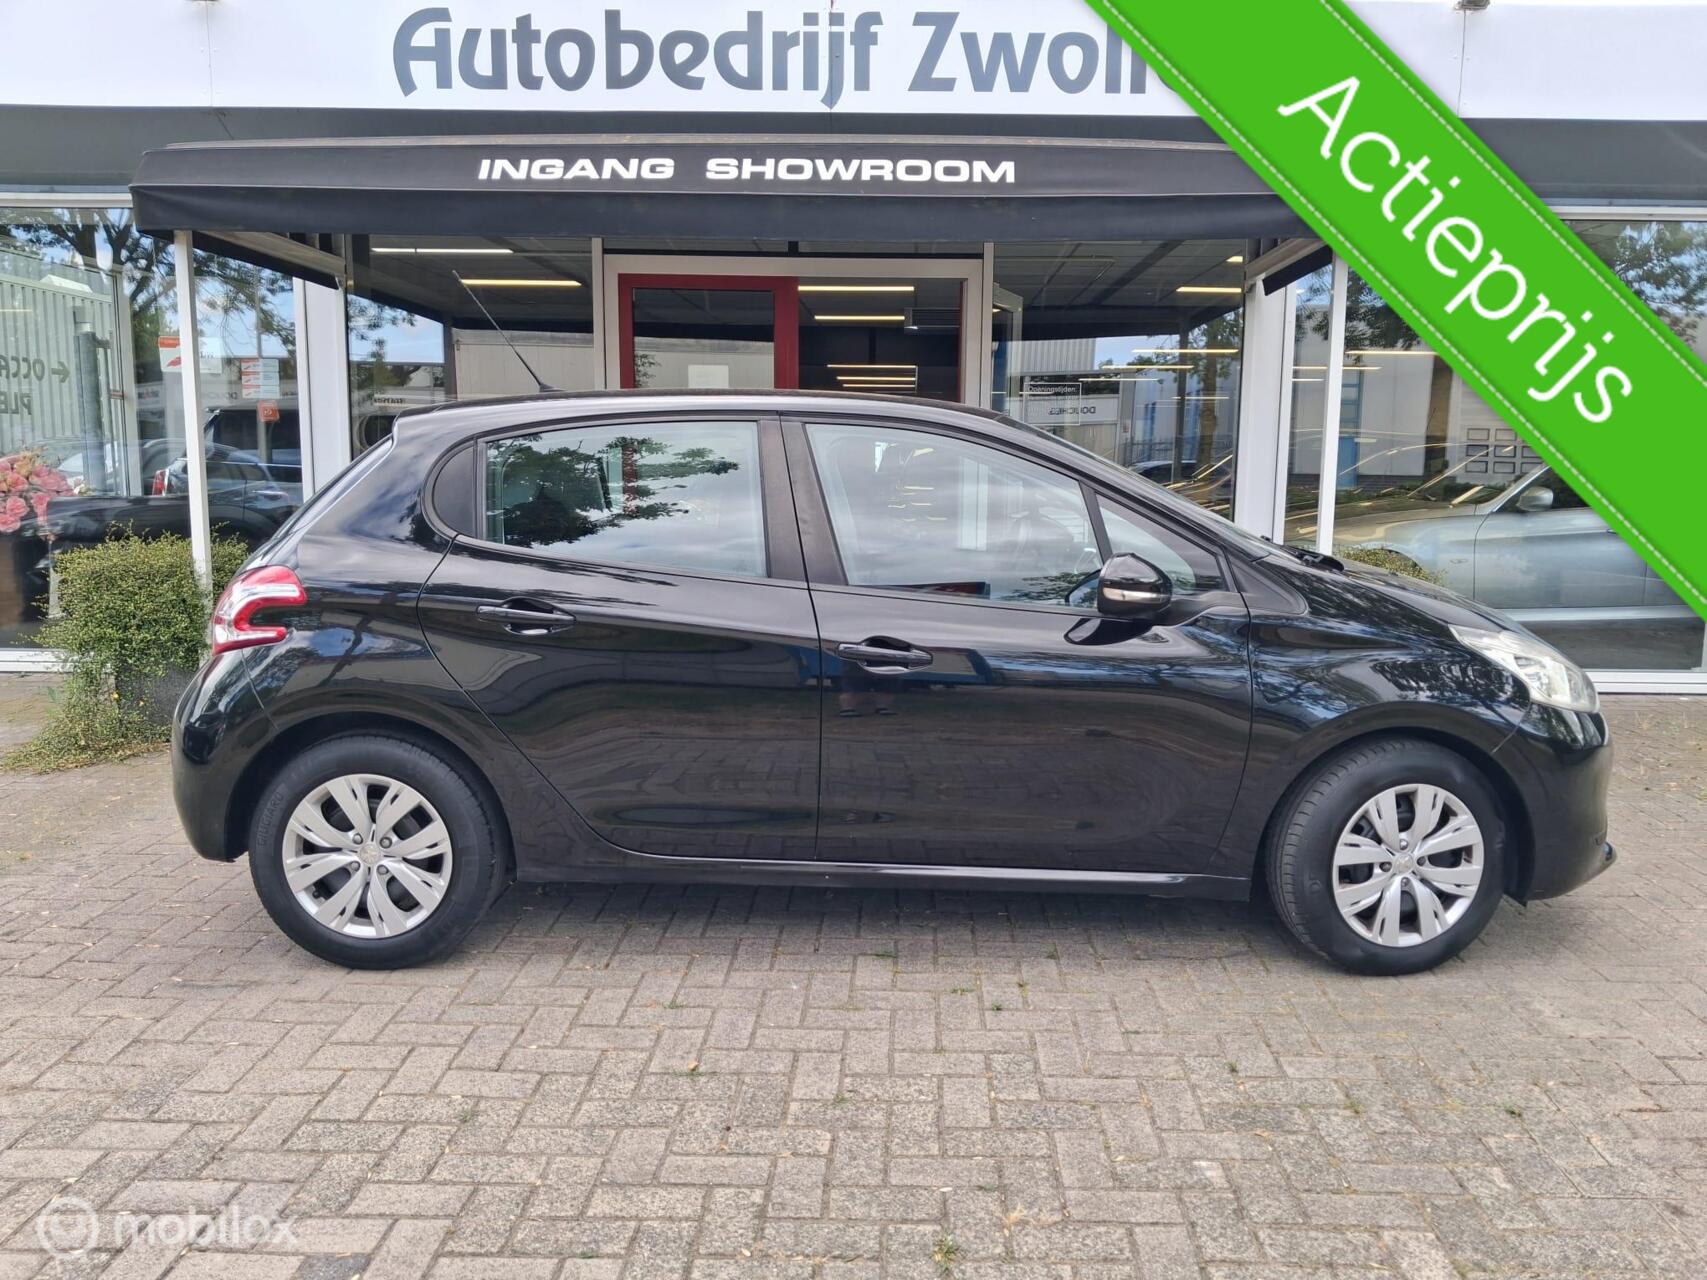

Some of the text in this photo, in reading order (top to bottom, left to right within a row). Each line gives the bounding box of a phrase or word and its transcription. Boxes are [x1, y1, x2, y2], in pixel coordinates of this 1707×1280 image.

[393, 7, 1178, 110] Autobedrijf Zwol
[478, 158, 1016, 183] INGANG SHOWROOM
